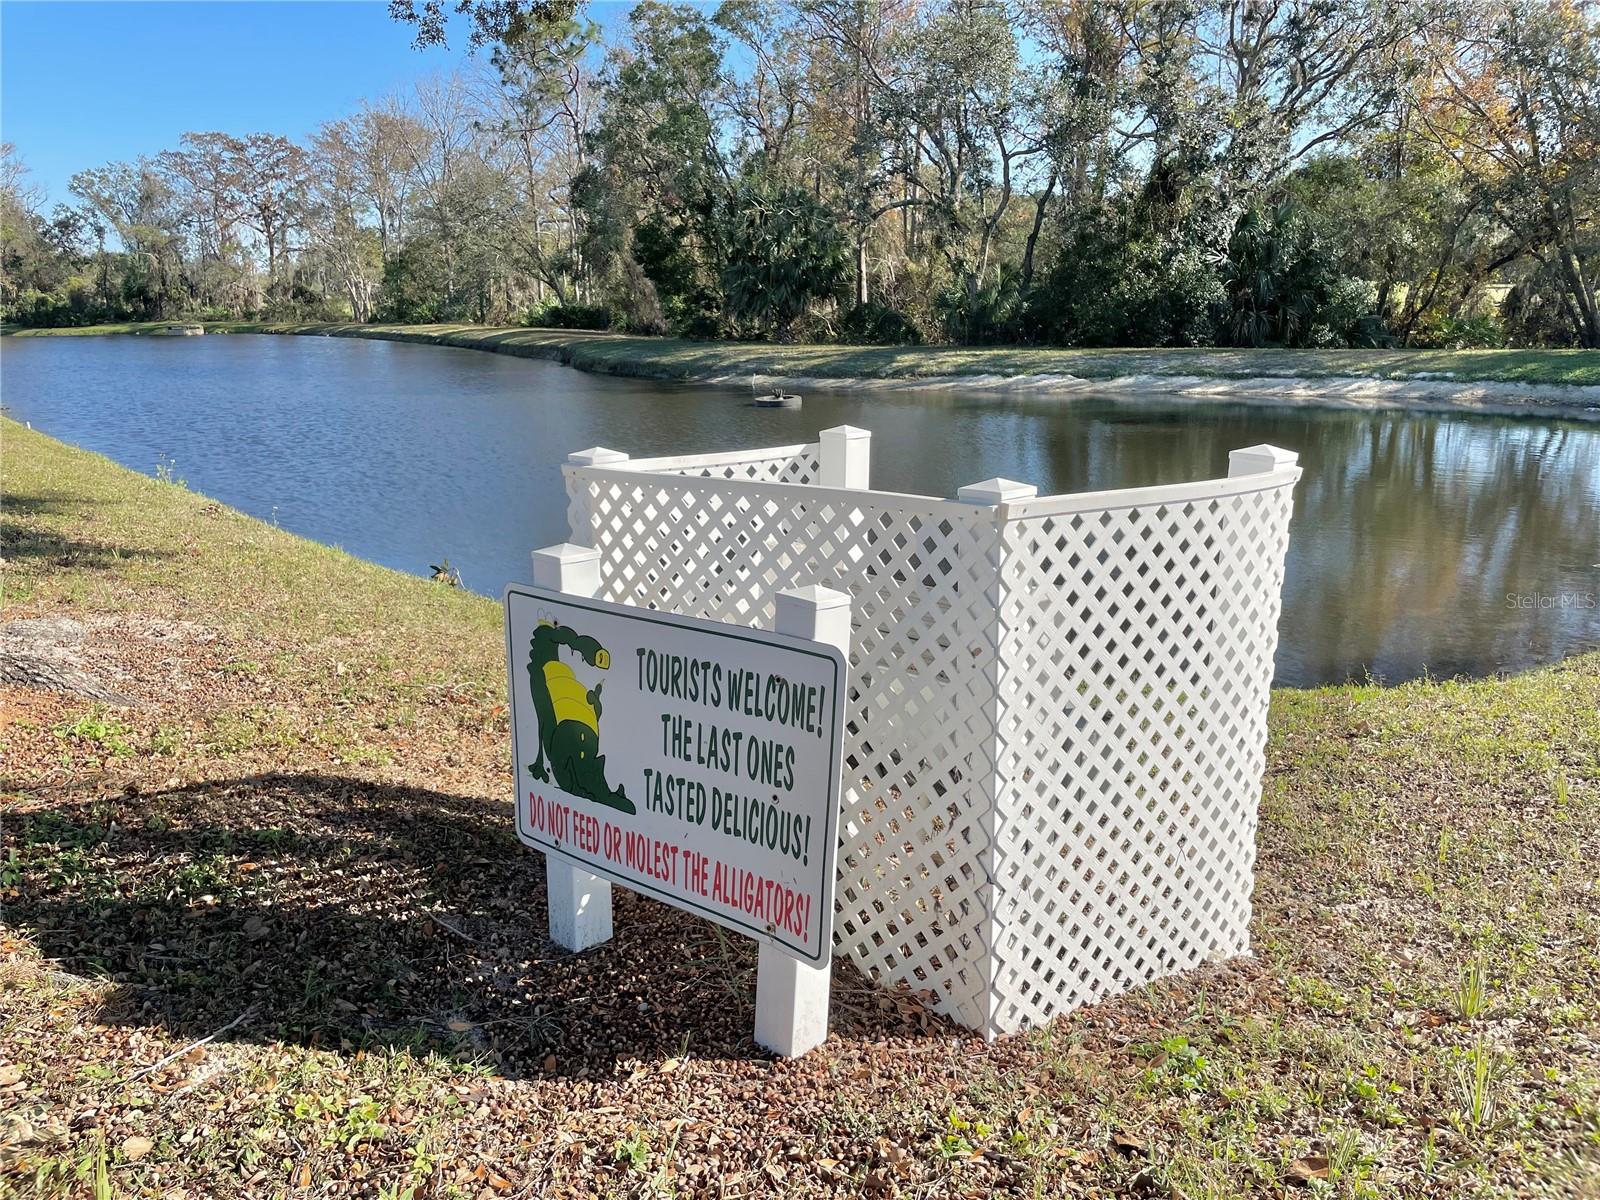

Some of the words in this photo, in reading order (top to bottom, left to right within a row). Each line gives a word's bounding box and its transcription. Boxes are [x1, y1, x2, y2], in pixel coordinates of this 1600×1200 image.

[636, 647, 722, 710] TOURISTS
[727, 667, 826, 739] WELCOME!
[661, 713, 692, 762] THE
[697, 722, 743, 777] LAST
[747, 735, 795, 792] ONES
[643, 768, 706, 826] TASTED
[712, 786, 811, 866] DELICIOUS!
[529, 791, 545, 831] DO
[547, 804, 570, 843] NOT
[572, 810, 600, 855] FEED
[603, 822, 622, 865] OR
[625, 831, 678, 886] MOLEST
[682, 850, 708, 897] THE
[712, 860, 811, 944] ALLIGATORS!
